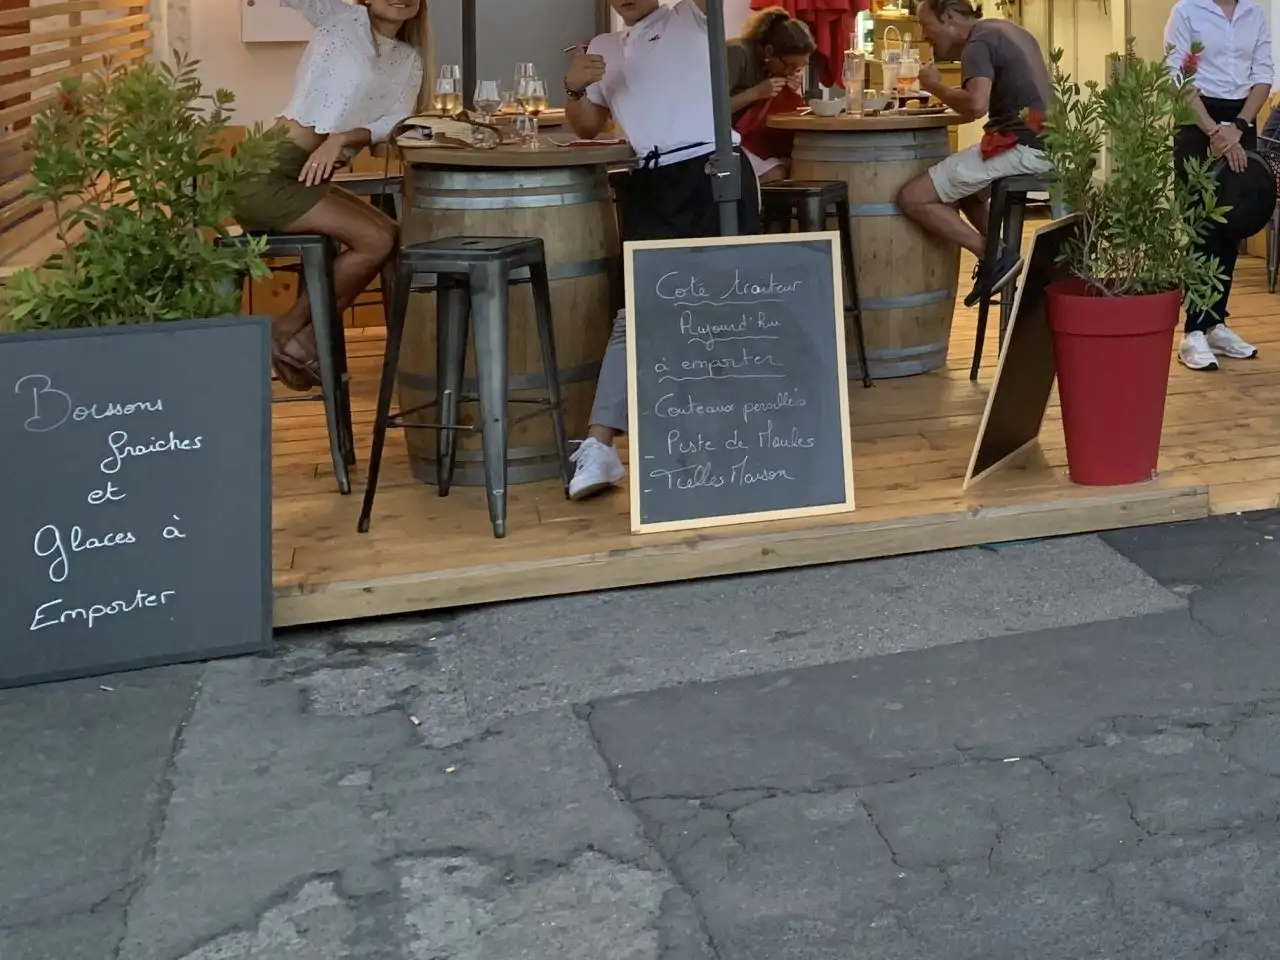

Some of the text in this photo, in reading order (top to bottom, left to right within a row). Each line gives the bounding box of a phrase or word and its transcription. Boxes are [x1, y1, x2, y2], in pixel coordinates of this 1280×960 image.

[654, 347, 785, 377] à emporter
[14, 373, 165, 432] Boissons
[654, 392, 735, 419] Couteaux
[725, 429, 749, 450] de
[758, 419, 817, 450] Moules
[730, 455, 797, 487] Maison
[87, 481, 127, 505] et
[33, 514, 186, 582] Glaces à
[29, 588, 176, 631] Emporter
